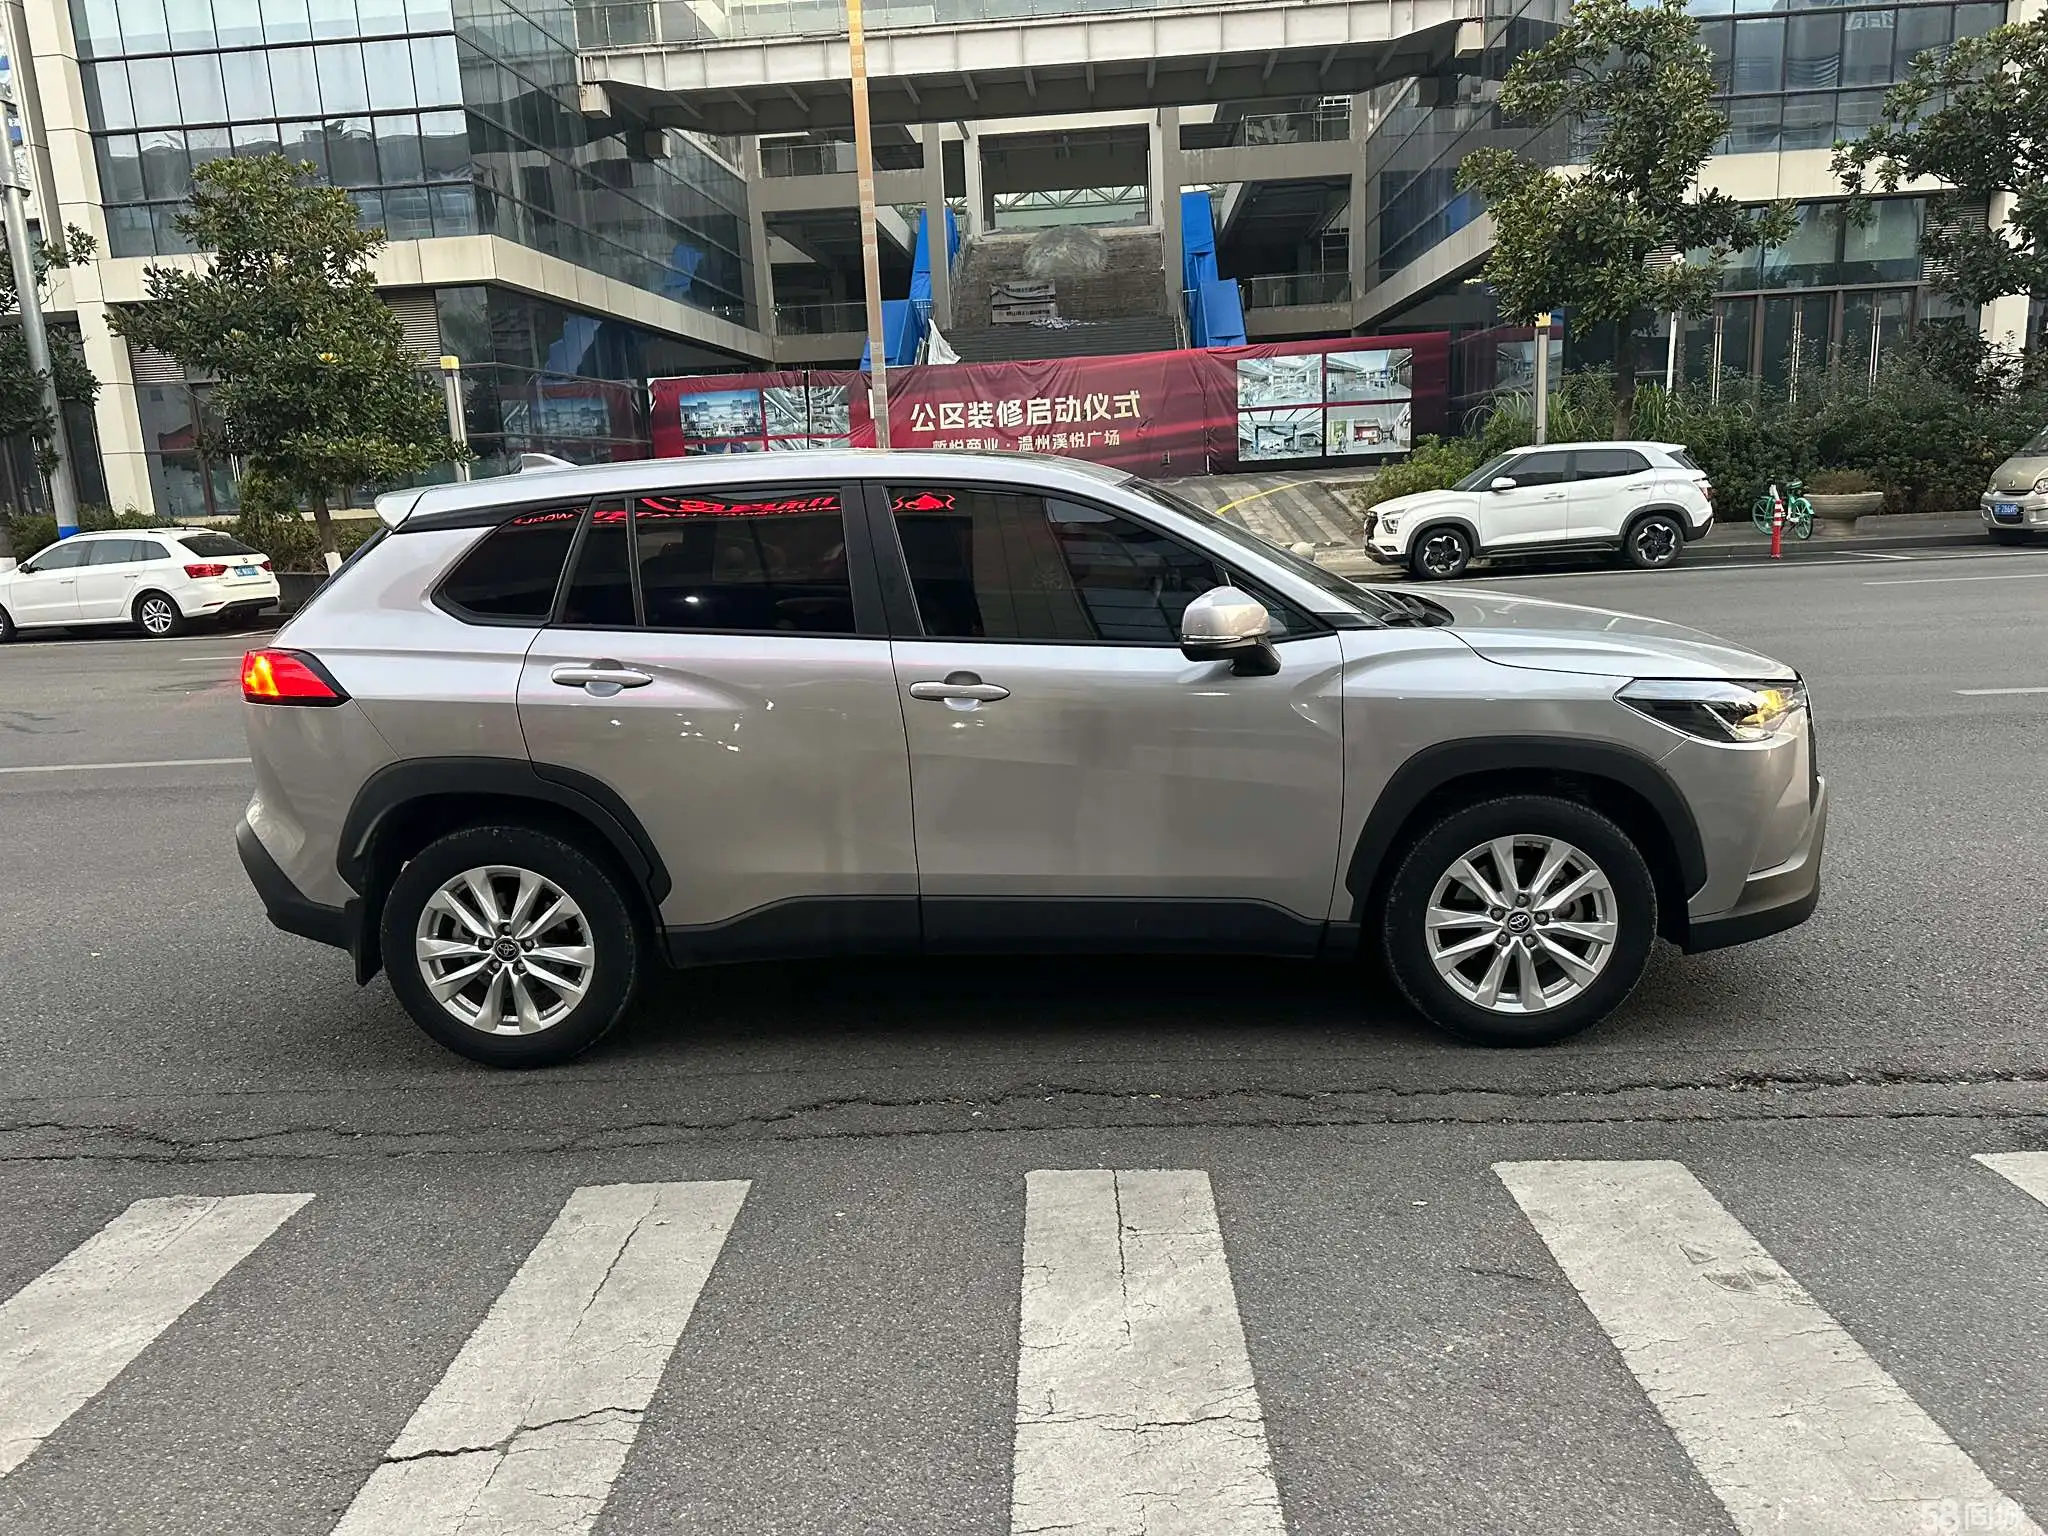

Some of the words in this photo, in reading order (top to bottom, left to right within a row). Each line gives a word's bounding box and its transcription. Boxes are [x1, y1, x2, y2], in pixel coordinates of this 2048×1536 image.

[910, 390, 1142, 432] 公区装修启动仪式
